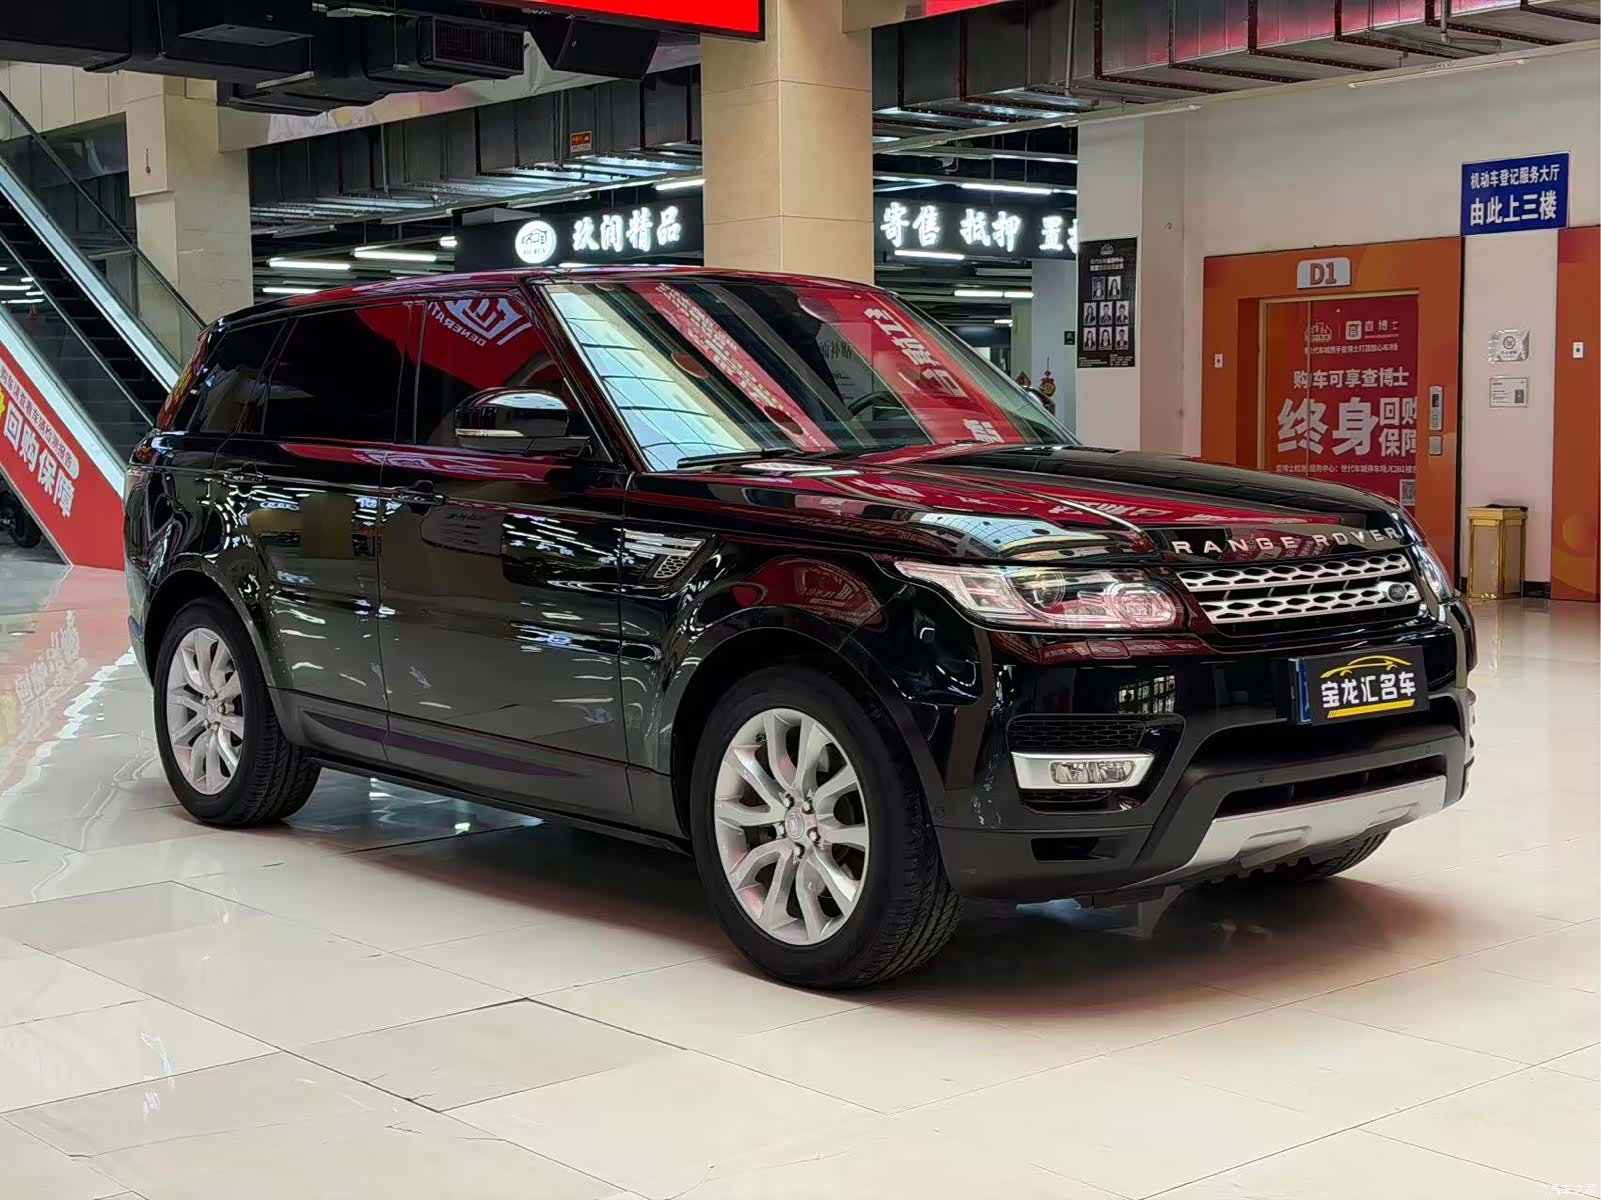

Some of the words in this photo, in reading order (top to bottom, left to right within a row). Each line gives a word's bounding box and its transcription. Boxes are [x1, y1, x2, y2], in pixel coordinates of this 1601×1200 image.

[1470, 164, 1560, 189] 机动车登记服务大厅
[880, 201, 941, 248] 寄售
[1470, 189, 1558, 226] 由此上三楼
[1309, 261, 1338, 286] D1
[1293, 367, 1410, 389] 购车可享查博士
[1277, 396, 1379, 457] 终身
[3, 400, 75, 518] 回购保障
[1171, 536, 1299, 554] RANGE
[1311, 527, 1402, 547] ROVER
[1320, 671, 1417, 708] 宝龙汇名车
